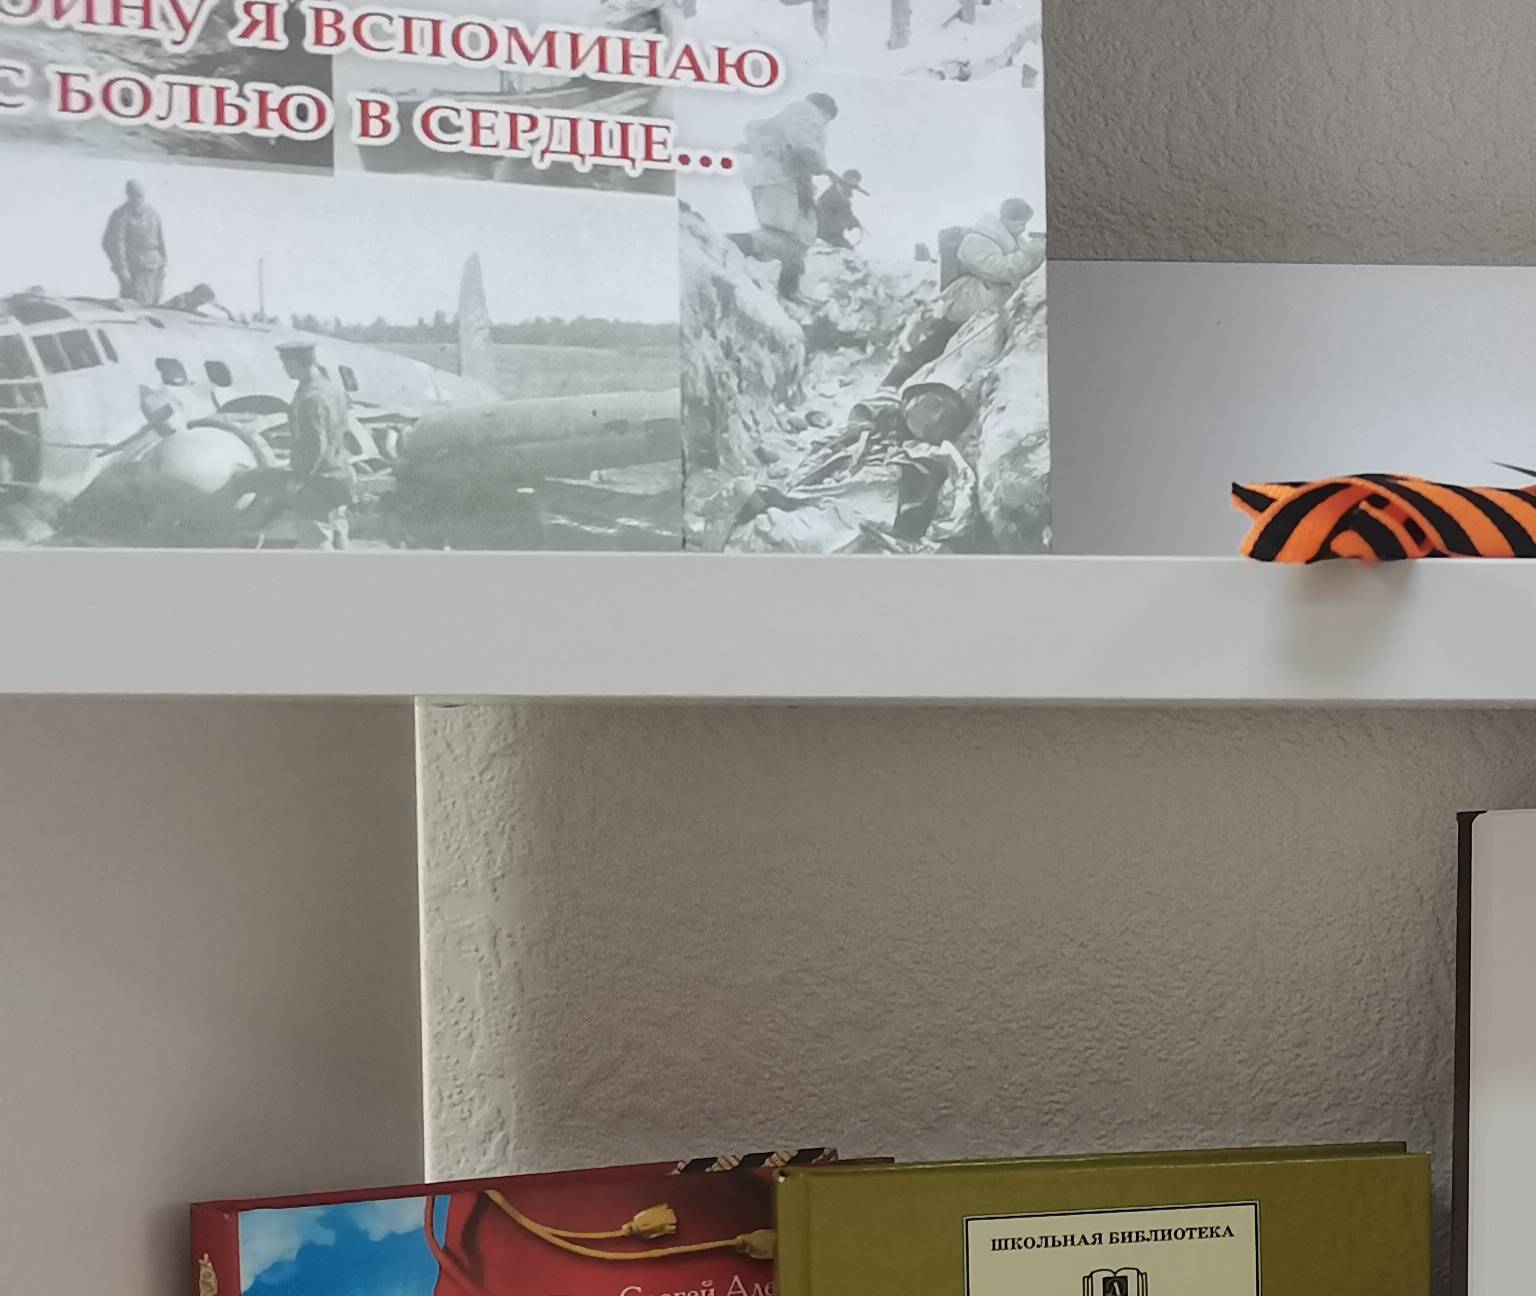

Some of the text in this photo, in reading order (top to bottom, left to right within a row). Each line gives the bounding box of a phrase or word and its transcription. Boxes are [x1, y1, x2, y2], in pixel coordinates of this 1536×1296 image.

[237, 1, 283, 43] Я
[312, 7, 780, 90] ВСПОМИНАЮ
[57, 71, 327, 134] БОЛЬЮ
[358, 99, 396, 142] В
[419, 102, 736, 172] СЕРДЦЕ...
[990, 1225, 1236, 1252] ШКОЛЬНАЯ БИБЛИОТЕКА
